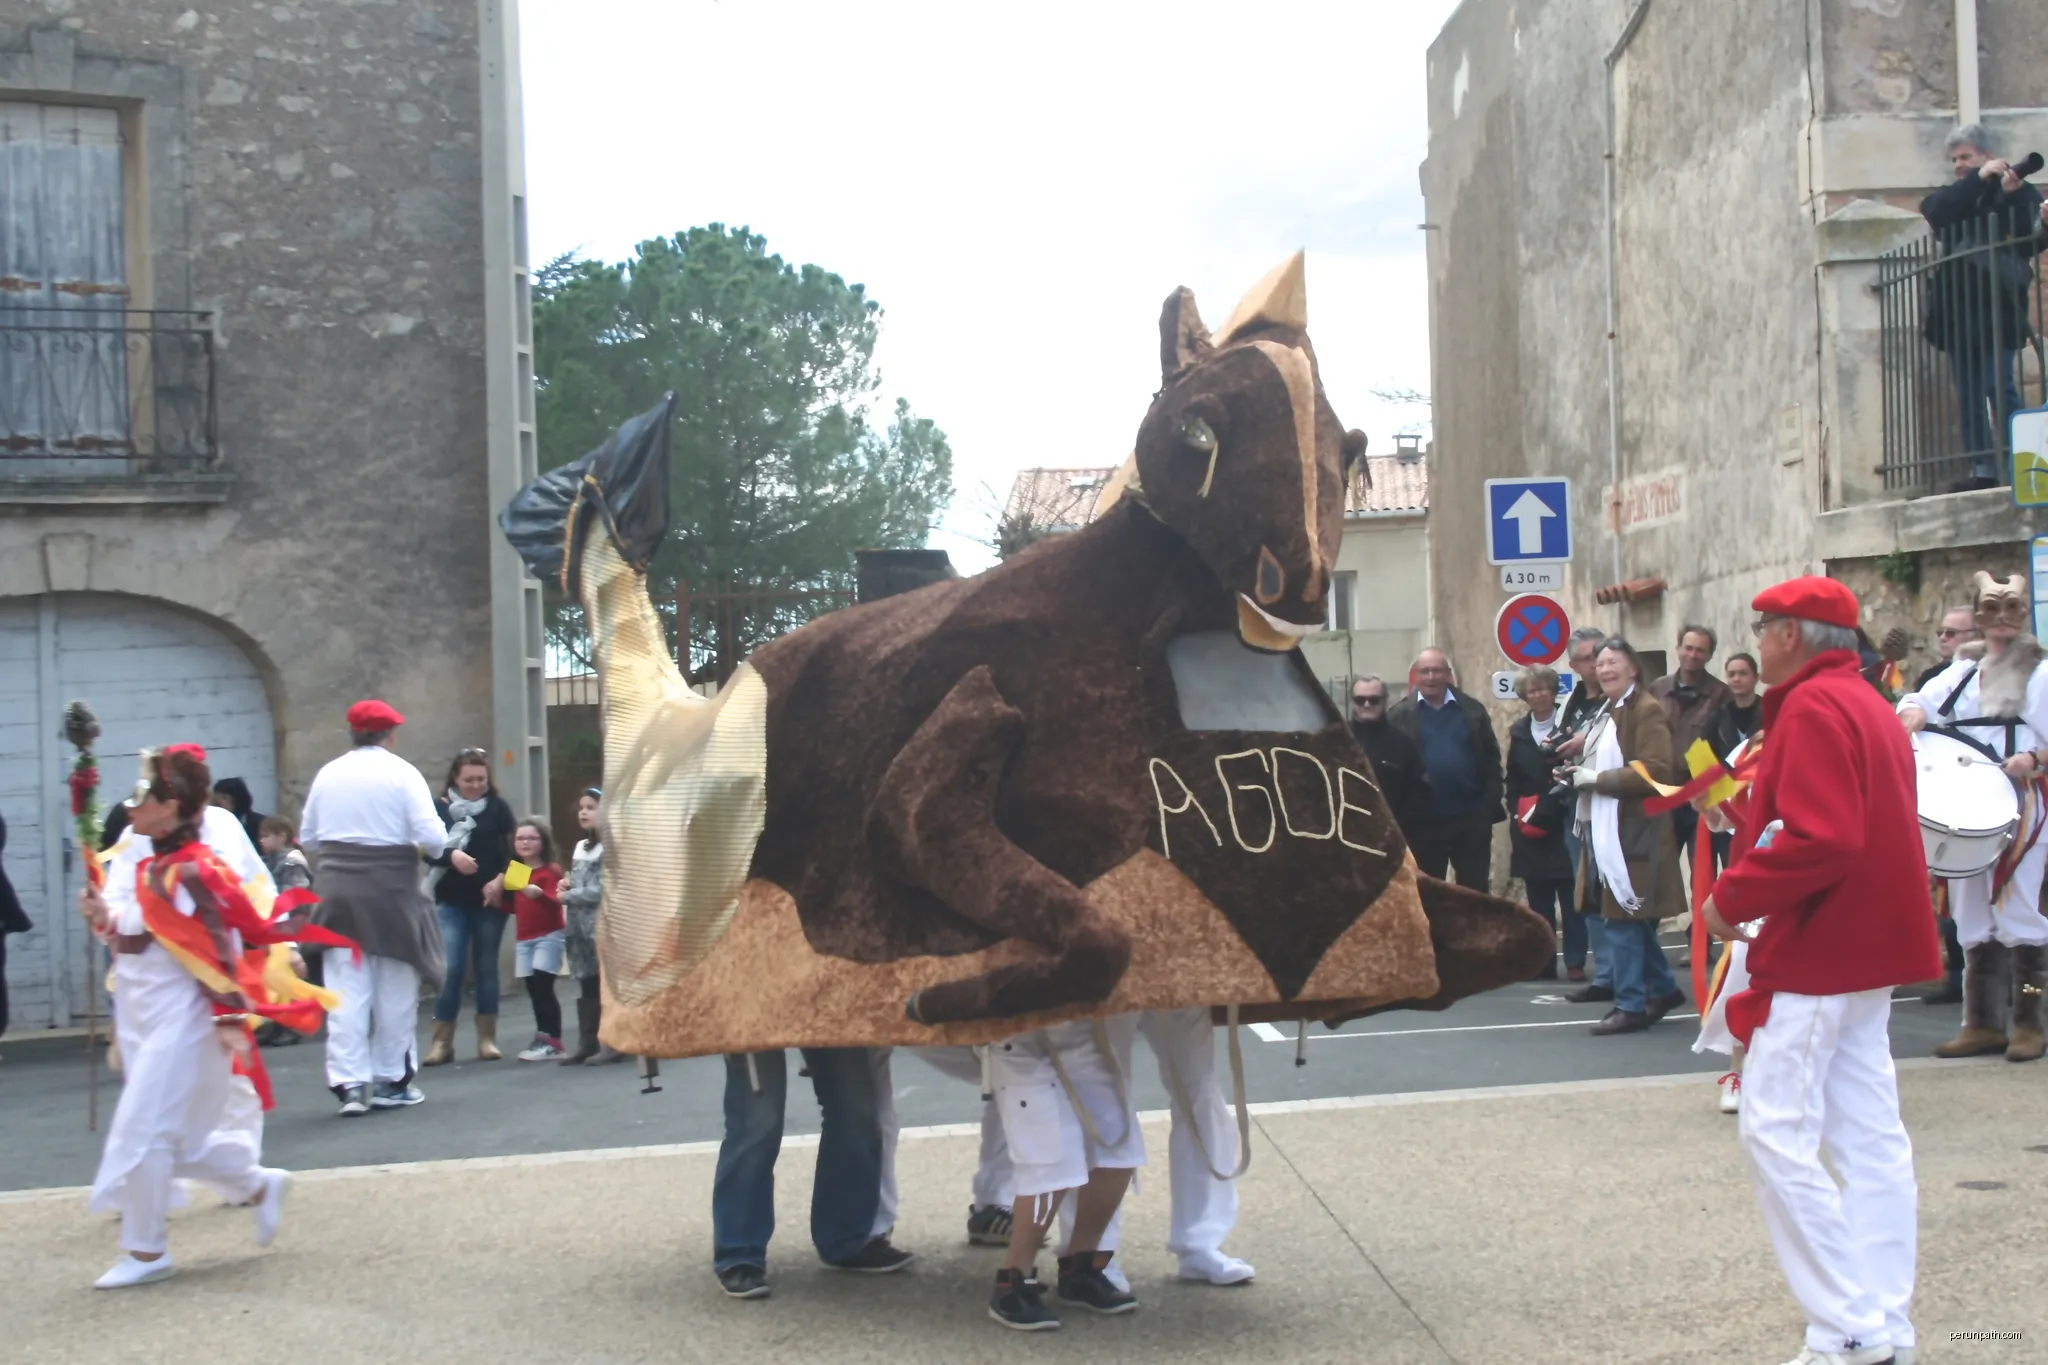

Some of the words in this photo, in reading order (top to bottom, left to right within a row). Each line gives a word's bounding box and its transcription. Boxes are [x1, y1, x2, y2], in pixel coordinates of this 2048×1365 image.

[1517, 572, 1535, 584] 30
[1539, 575, 1550, 583] m
[1150, 747, 1387, 859] AGDE
